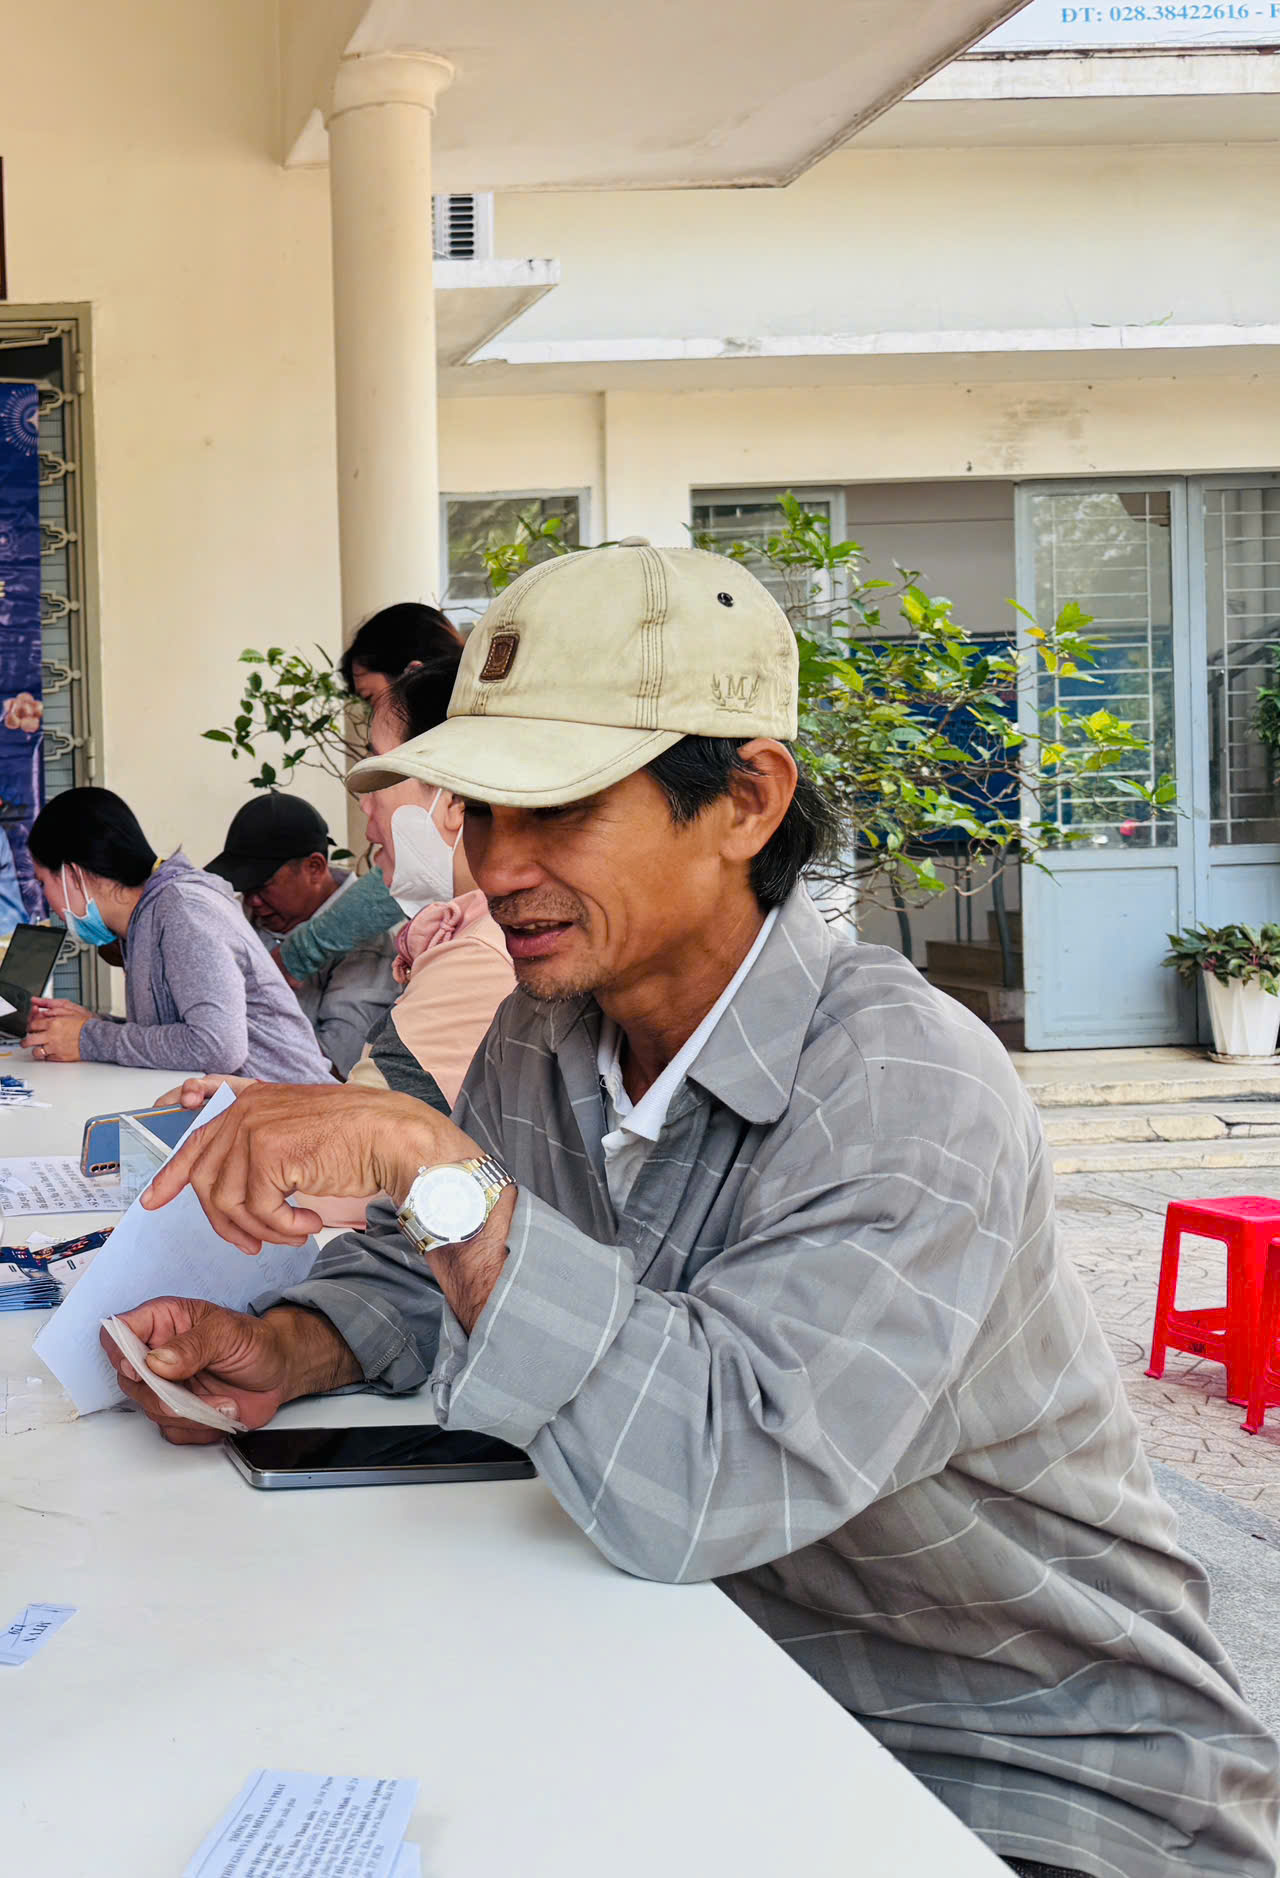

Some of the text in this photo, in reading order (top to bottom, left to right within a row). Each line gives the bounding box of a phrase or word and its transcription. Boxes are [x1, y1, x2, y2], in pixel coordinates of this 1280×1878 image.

[1061, 7, 1102, 23] ĐT:
[1110, 4, 1249, 22] 028.38422616
[726, 676, 747, 701] M
